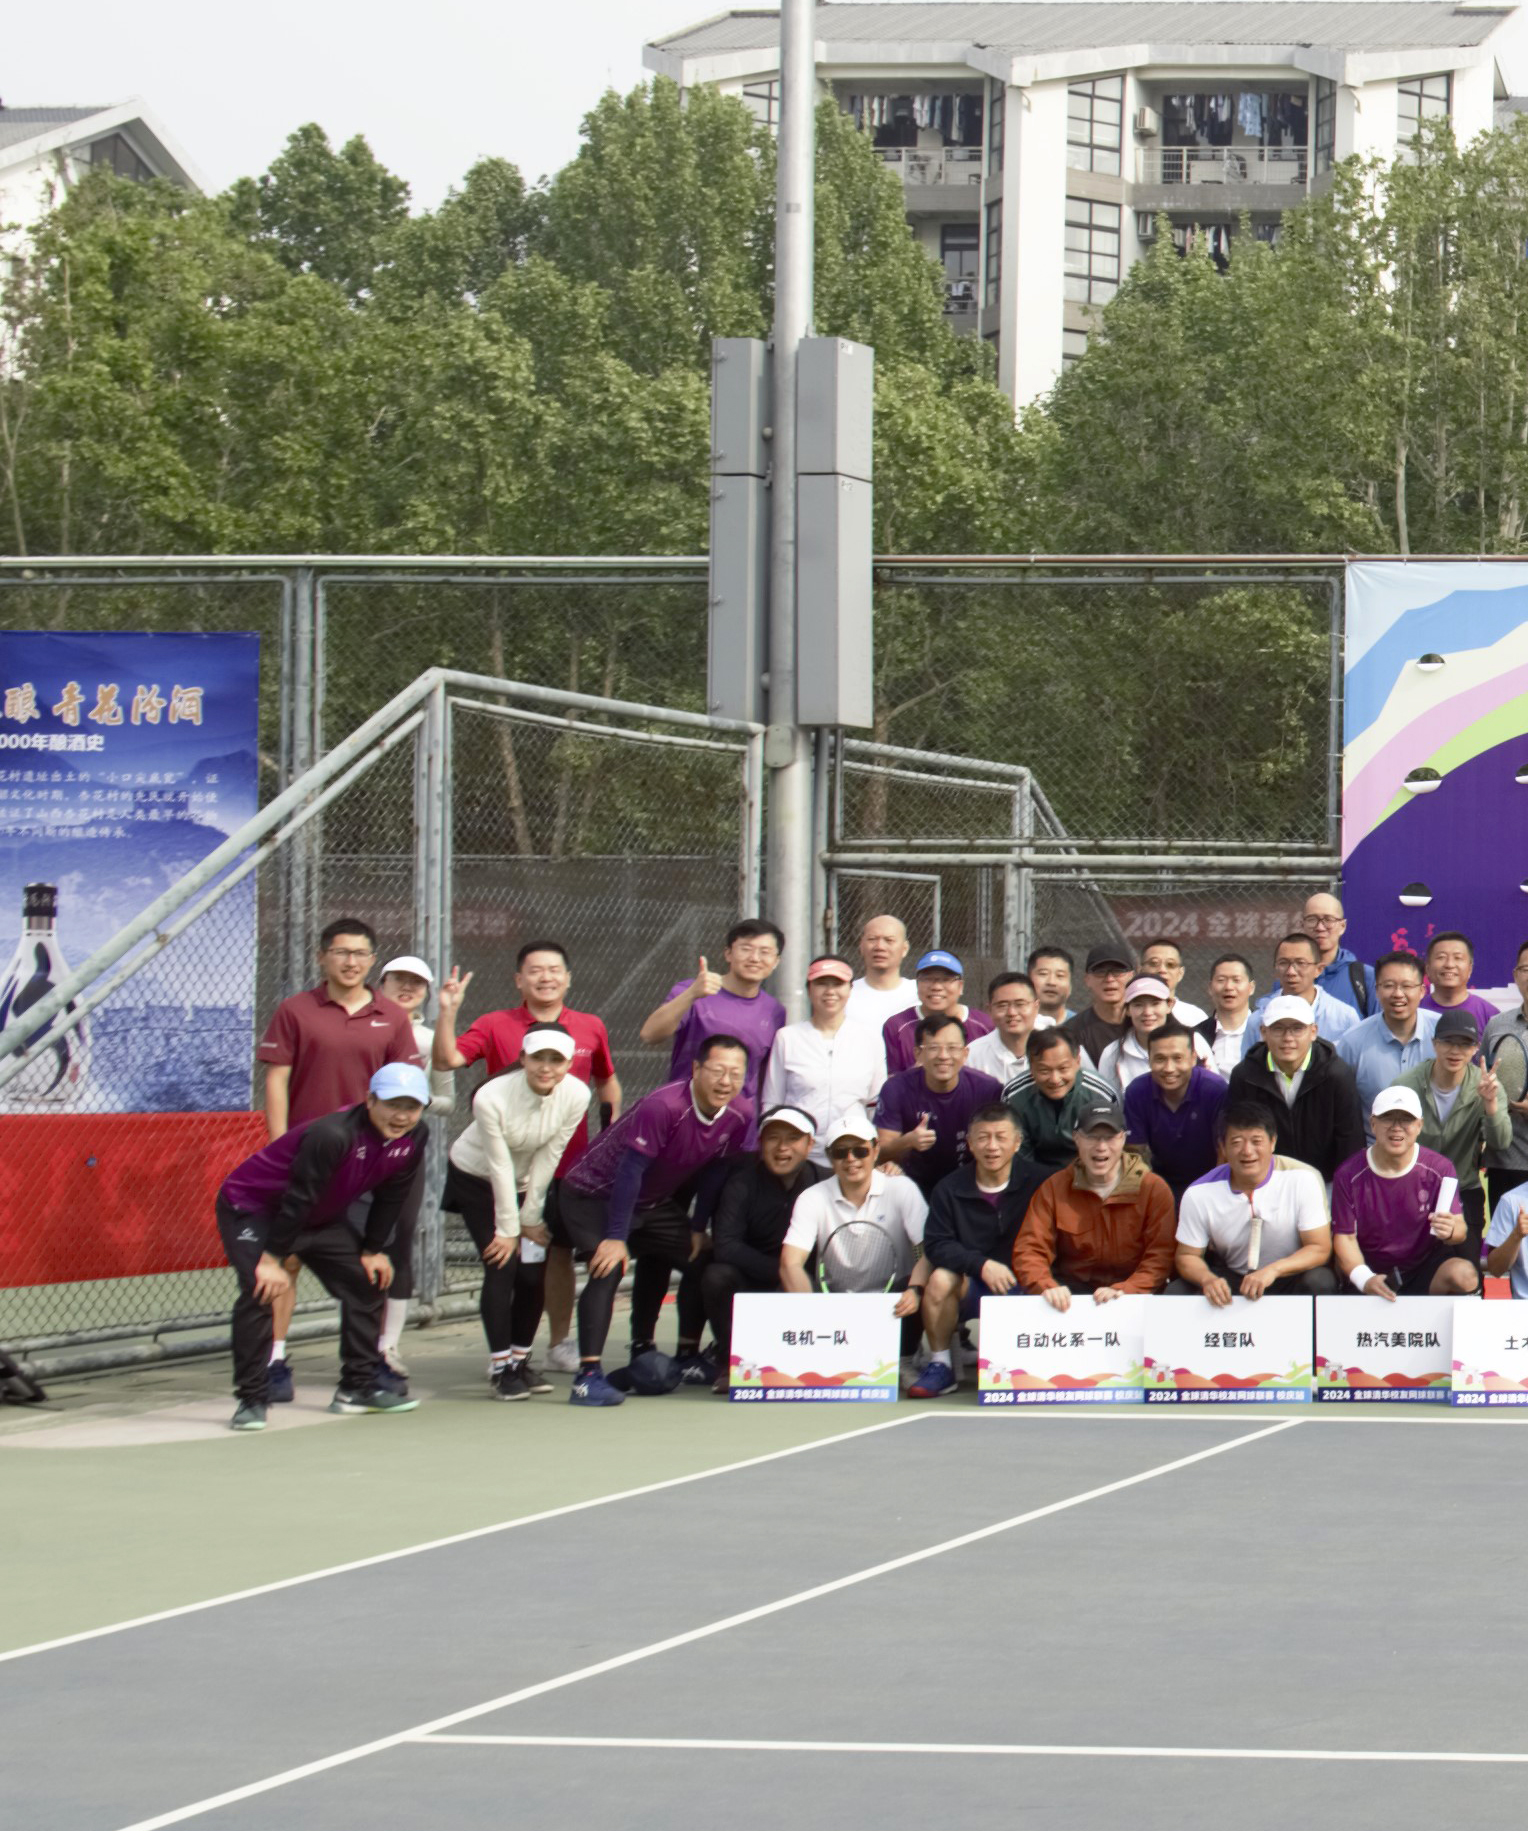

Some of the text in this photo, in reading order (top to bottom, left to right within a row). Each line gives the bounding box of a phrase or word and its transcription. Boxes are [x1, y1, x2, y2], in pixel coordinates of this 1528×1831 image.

[52, 680, 204, 727] 青花汾酒
[1126, 910, 1199, 937] 2024
[782, 1329, 849, 1346] 电机一队
[1016, 1331, 1121, 1348] 自动化系一队
[1204, 1331, 1256, 1349] 经管队
[734, 1389, 764, 1400] 2024
[983, 1392, 1014, 1404] 2024
[1148, 1391, 1178, 1401] 2024
[1322, 1390, 1351, 1400] 2024
[1456, 1394, 1486, 1405] 2024
